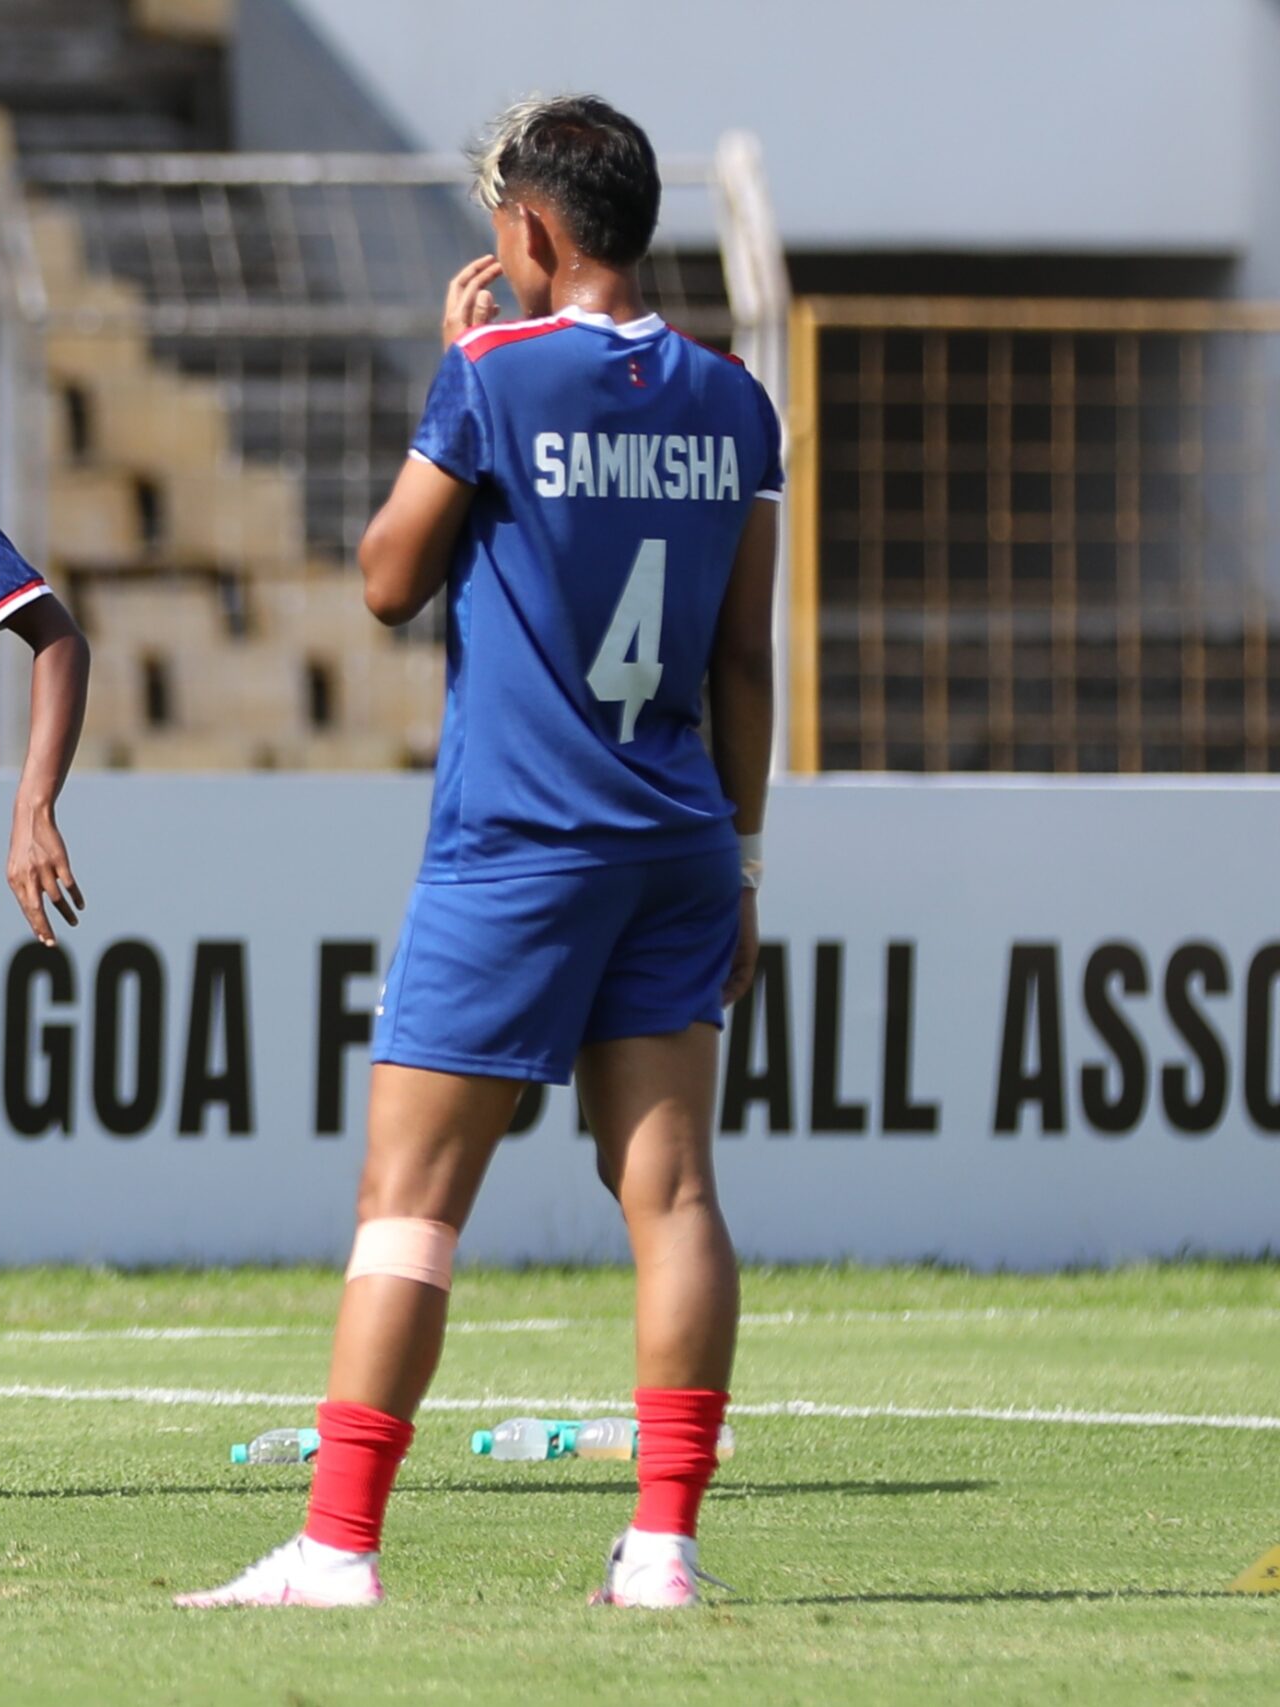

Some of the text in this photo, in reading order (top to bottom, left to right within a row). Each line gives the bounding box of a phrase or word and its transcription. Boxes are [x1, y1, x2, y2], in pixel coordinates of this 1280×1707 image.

[533, 431, 740, 501] SAMIKSHA
[586, 539, 667, 743] 4
[1, 937, 255, 1139] GOA
